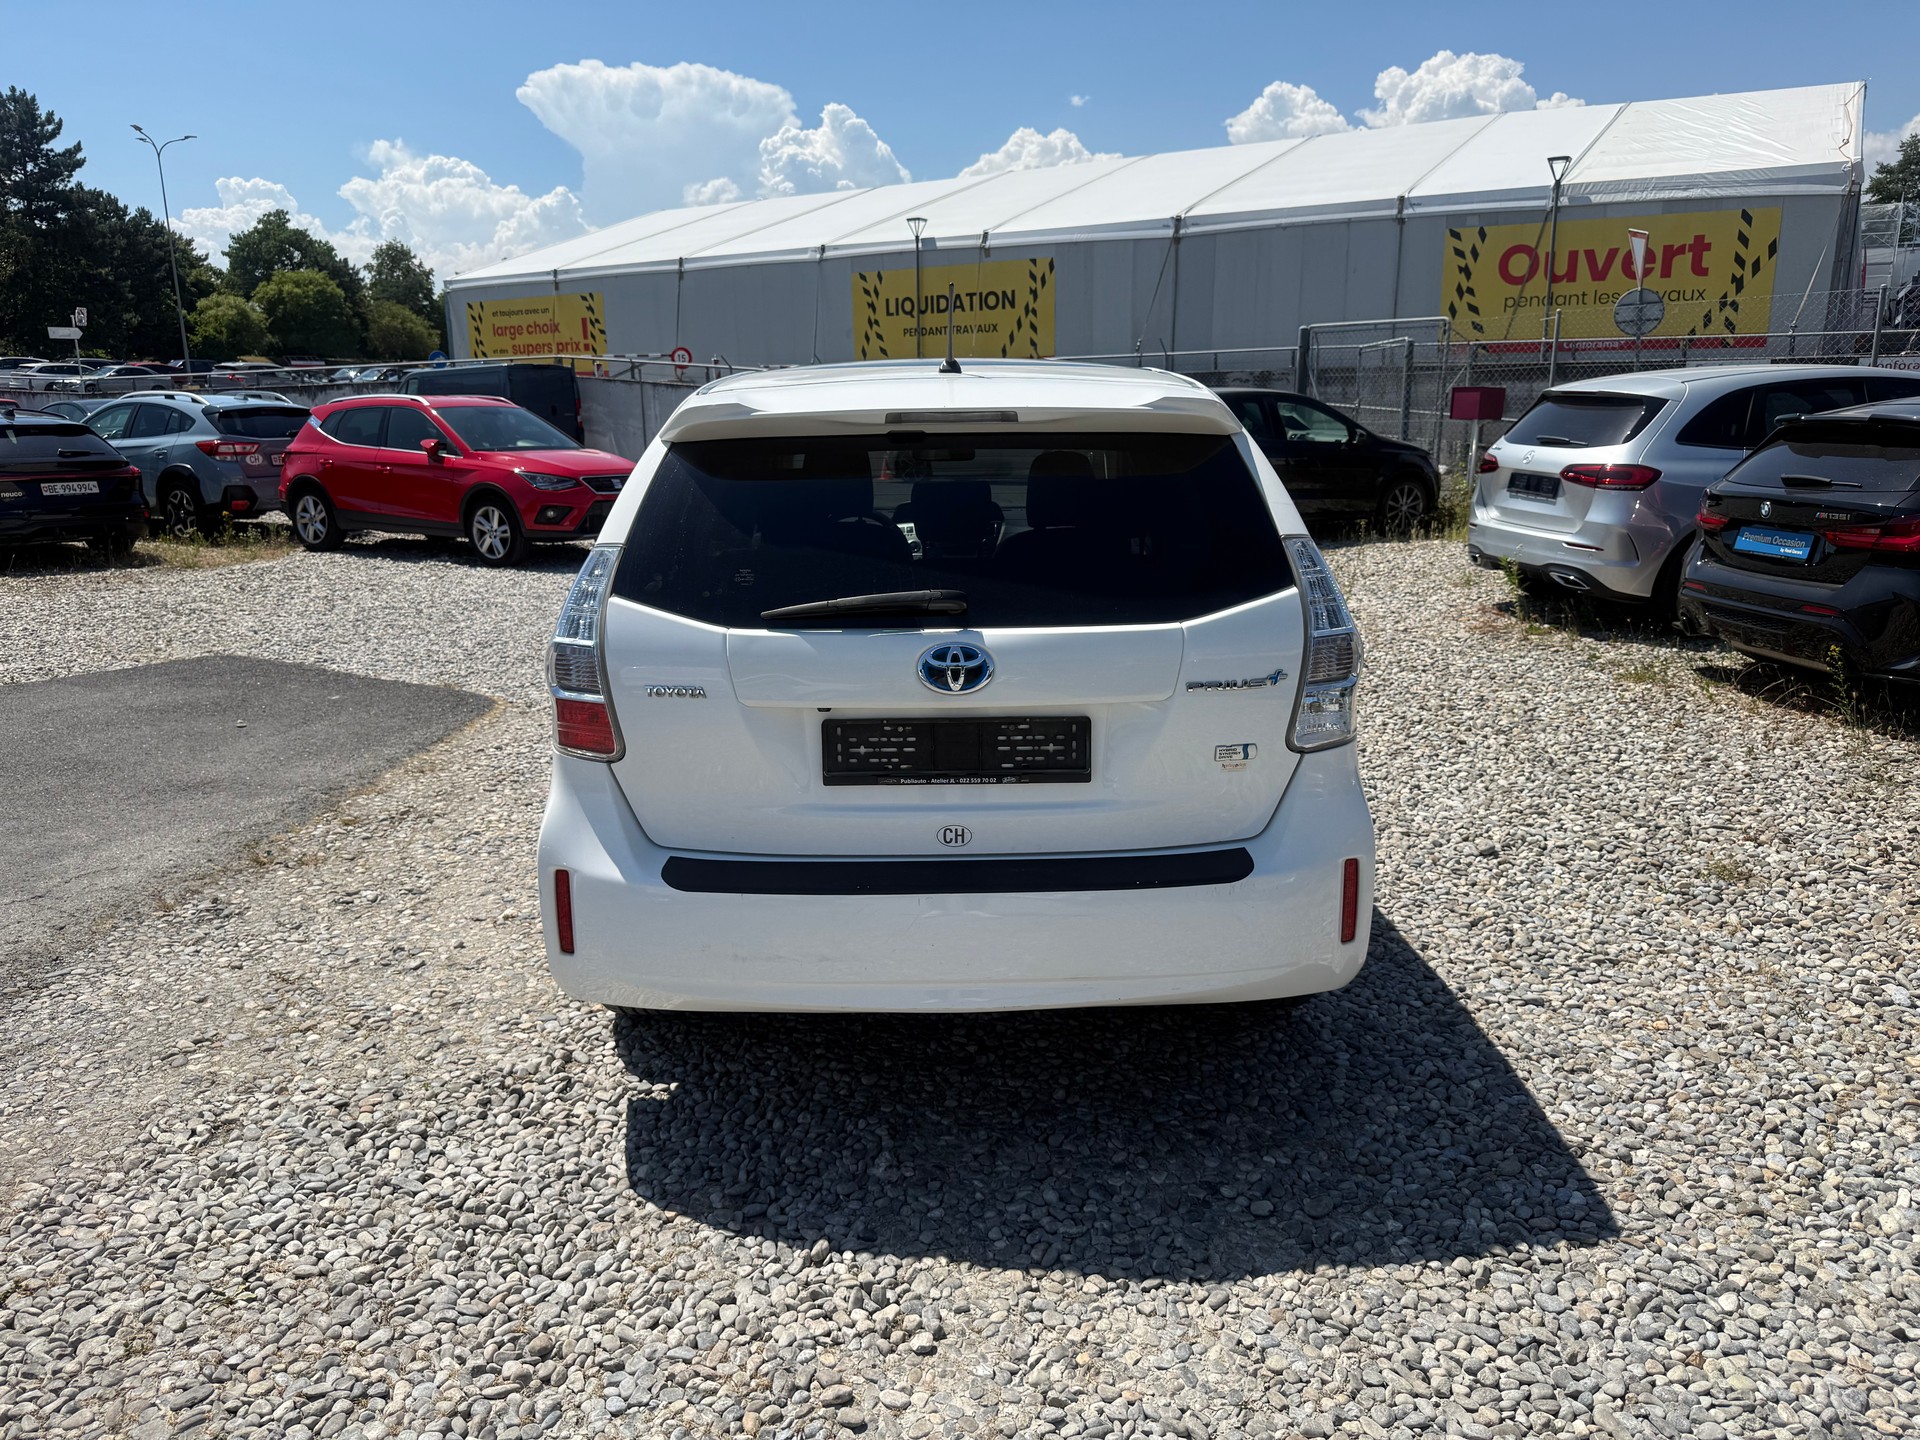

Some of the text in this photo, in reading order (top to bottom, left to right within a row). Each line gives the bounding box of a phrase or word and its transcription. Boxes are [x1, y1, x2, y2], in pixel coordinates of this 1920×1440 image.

[1498, 235, 1712, 286] Ouvert
[885, 289, 1016, 318] LIQUIDATION
[1503, 290, 1588, 313] pendant
[1593, 289, 1620, 305] les
[492, 309, 499, 317] et
[499, 308, 524, 318] toujours
[524, 308, 540, 316] avec
[493, 319, 560, 340] large choix
[903, 323, 999, 337] PENDANT TRAVAUX
[512, 342, 553, 356] supers
[556, 337, 581, 355] prix
[677, 354, 686, 362] 15
[1743, 531, 1806, 549] Premium Occasion
[643, 684, 708, 699] TOYOTA
[942, 828, 966, 844] CH
